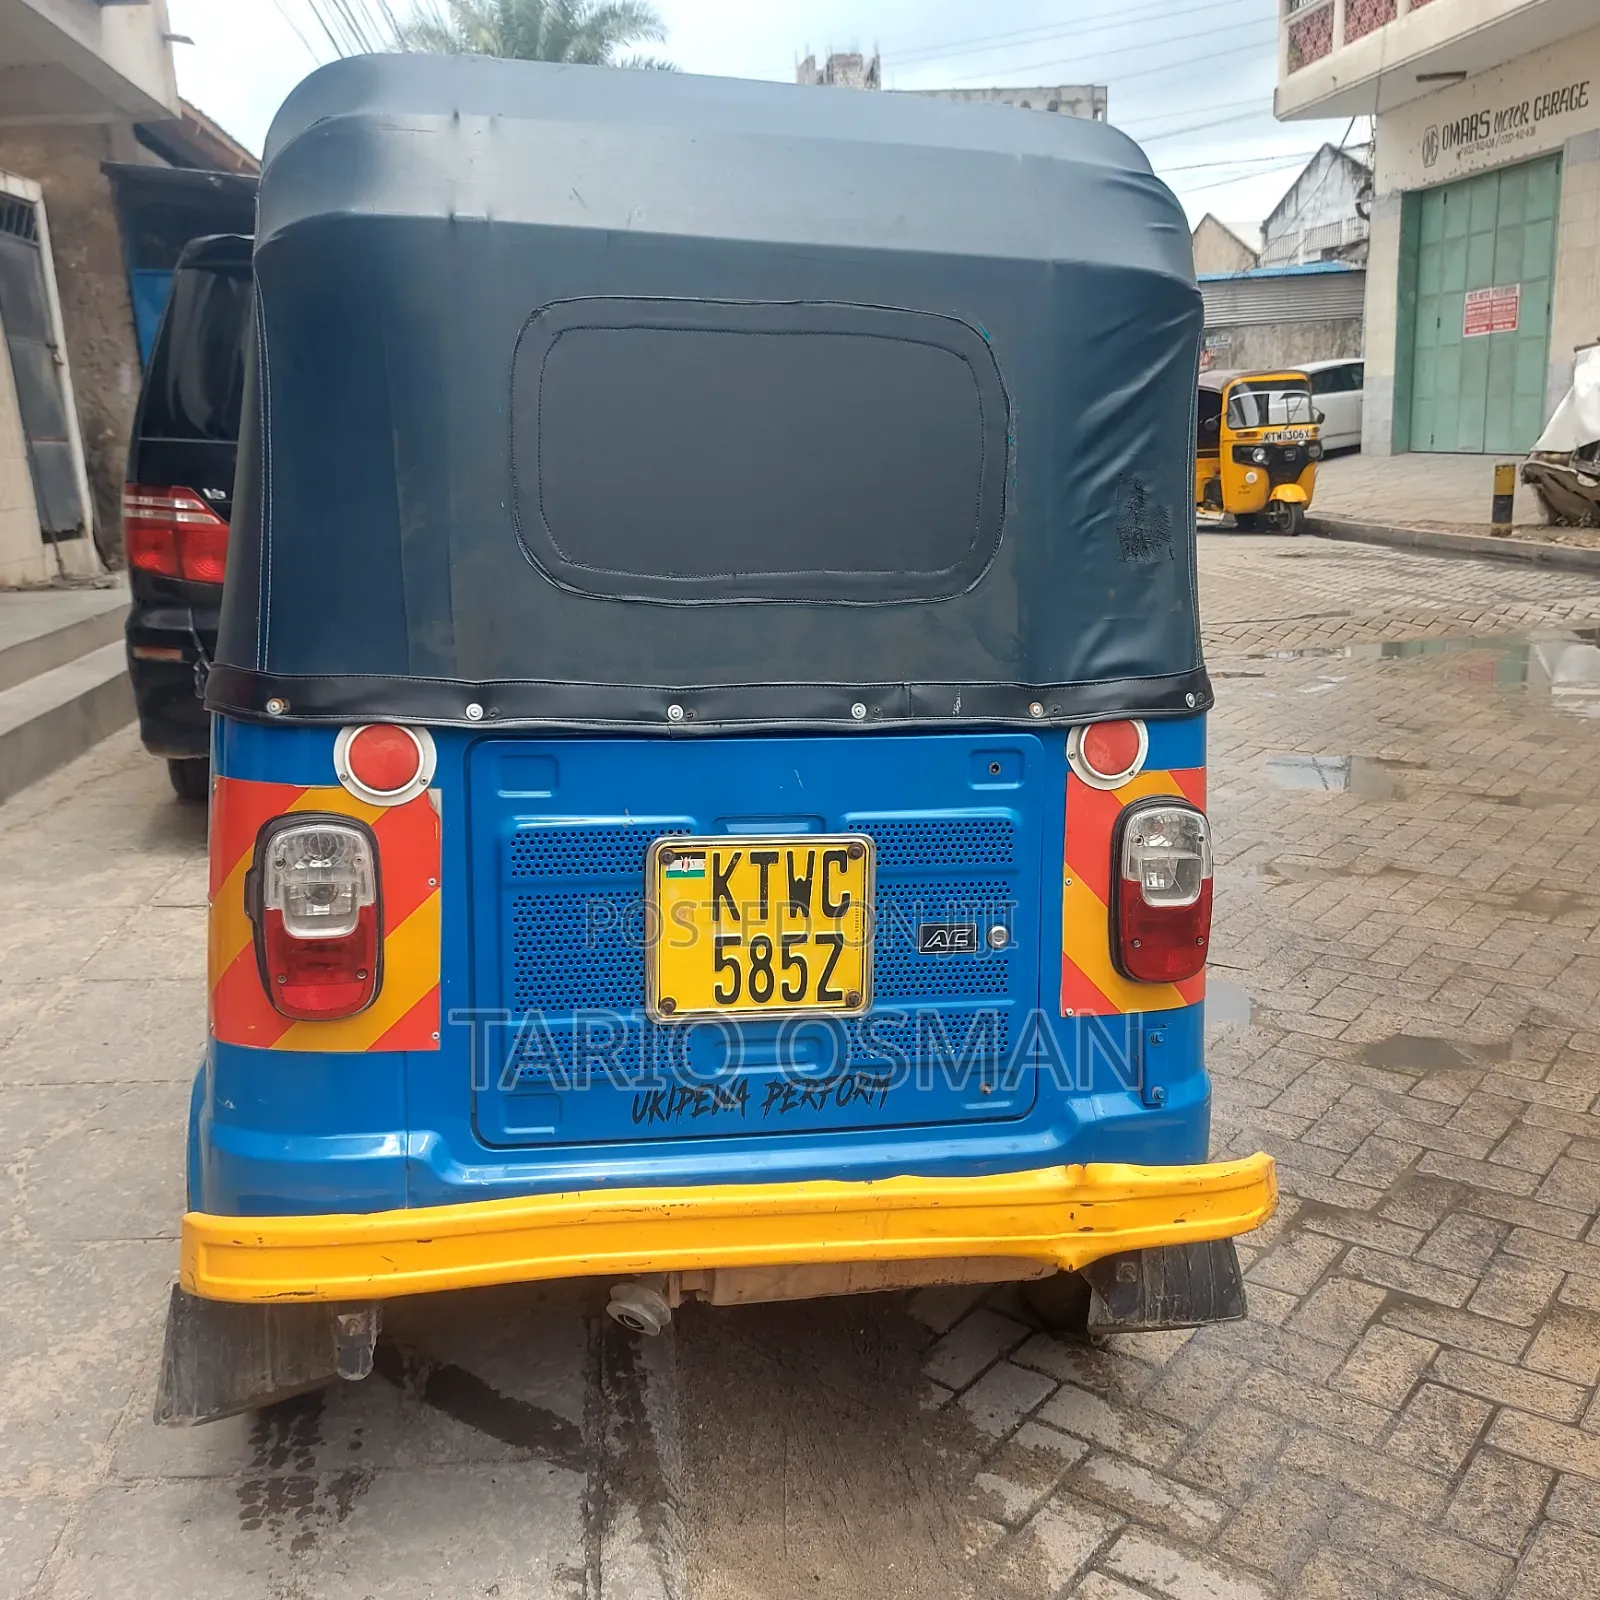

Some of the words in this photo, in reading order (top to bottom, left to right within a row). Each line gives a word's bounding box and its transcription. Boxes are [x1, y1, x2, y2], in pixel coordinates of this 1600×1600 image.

[1442, 108, 1490, 151] OMARS
[1494, 101, 1530, 134] MOTOR
[1534, 81, 1590, 121] GARAGE
[711, 849, 851, 922] KTWC
[714, 934, 844, 1005] 585Z
[631, 1077, 751, 1126] UKIPEWA
[760, 1069, 892, 1120] PERFORM
